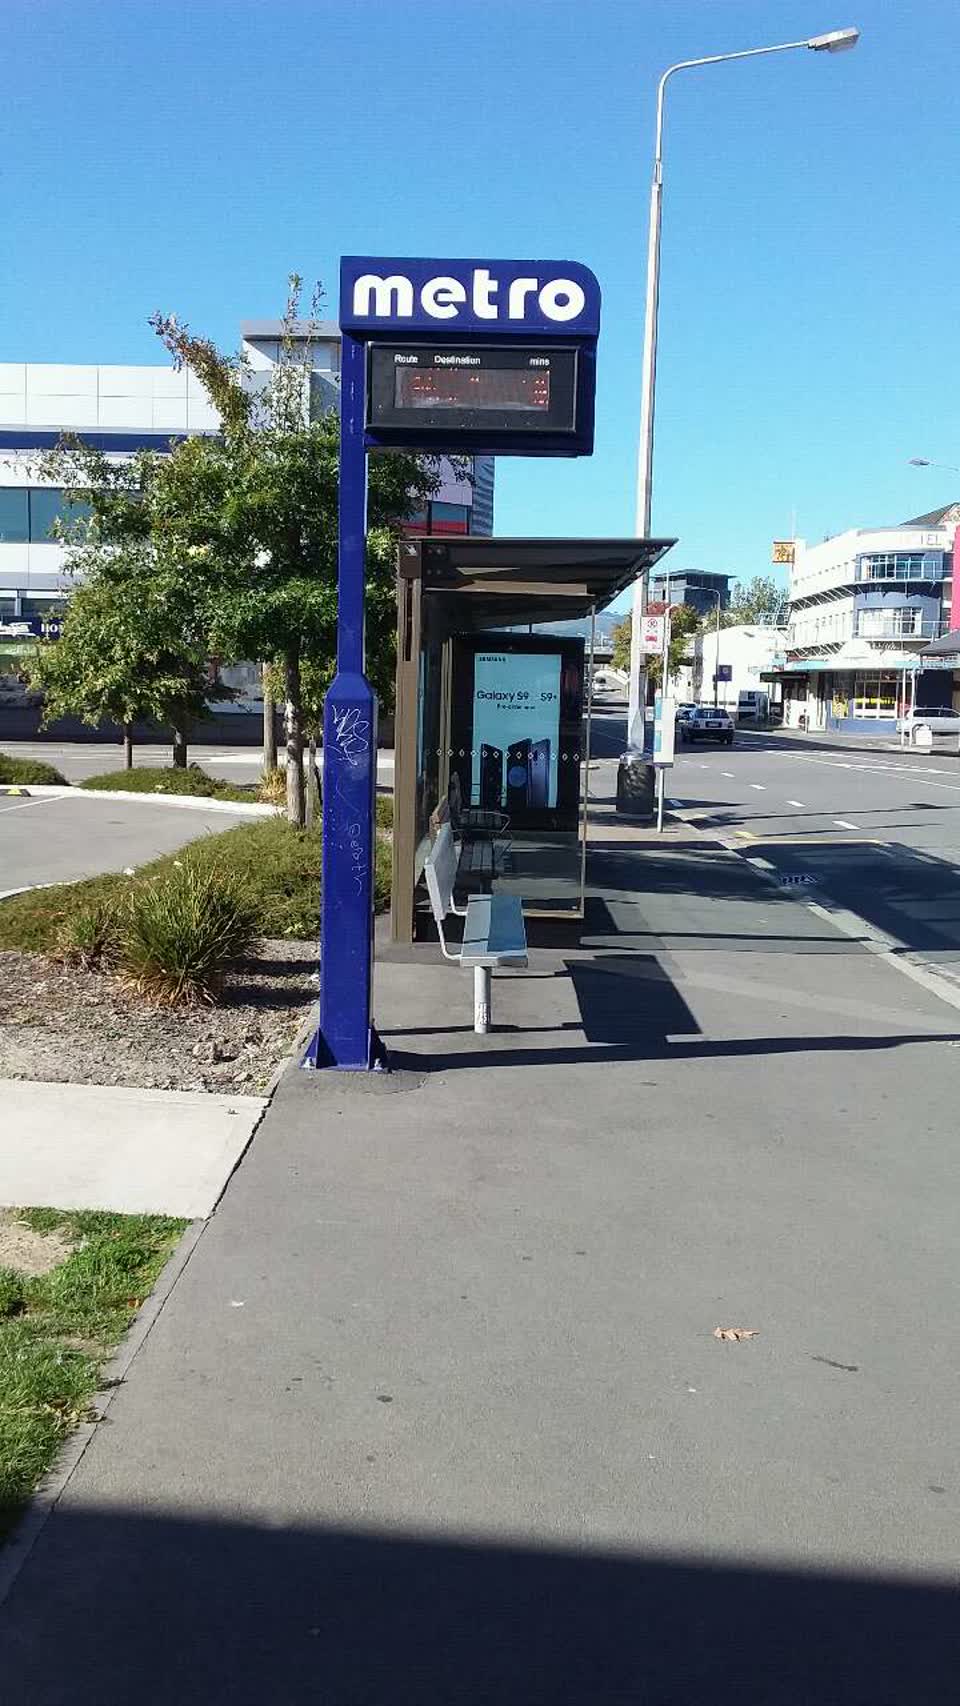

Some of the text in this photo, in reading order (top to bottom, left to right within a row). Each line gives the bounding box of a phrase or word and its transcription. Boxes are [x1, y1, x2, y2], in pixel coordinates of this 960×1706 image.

[353, 268, 586, 322] metro
[394, 354, 550, 366] Route Destination mins
[476, 690, 515, 702] Galaxy
[516, 690, 529, 701] S9
